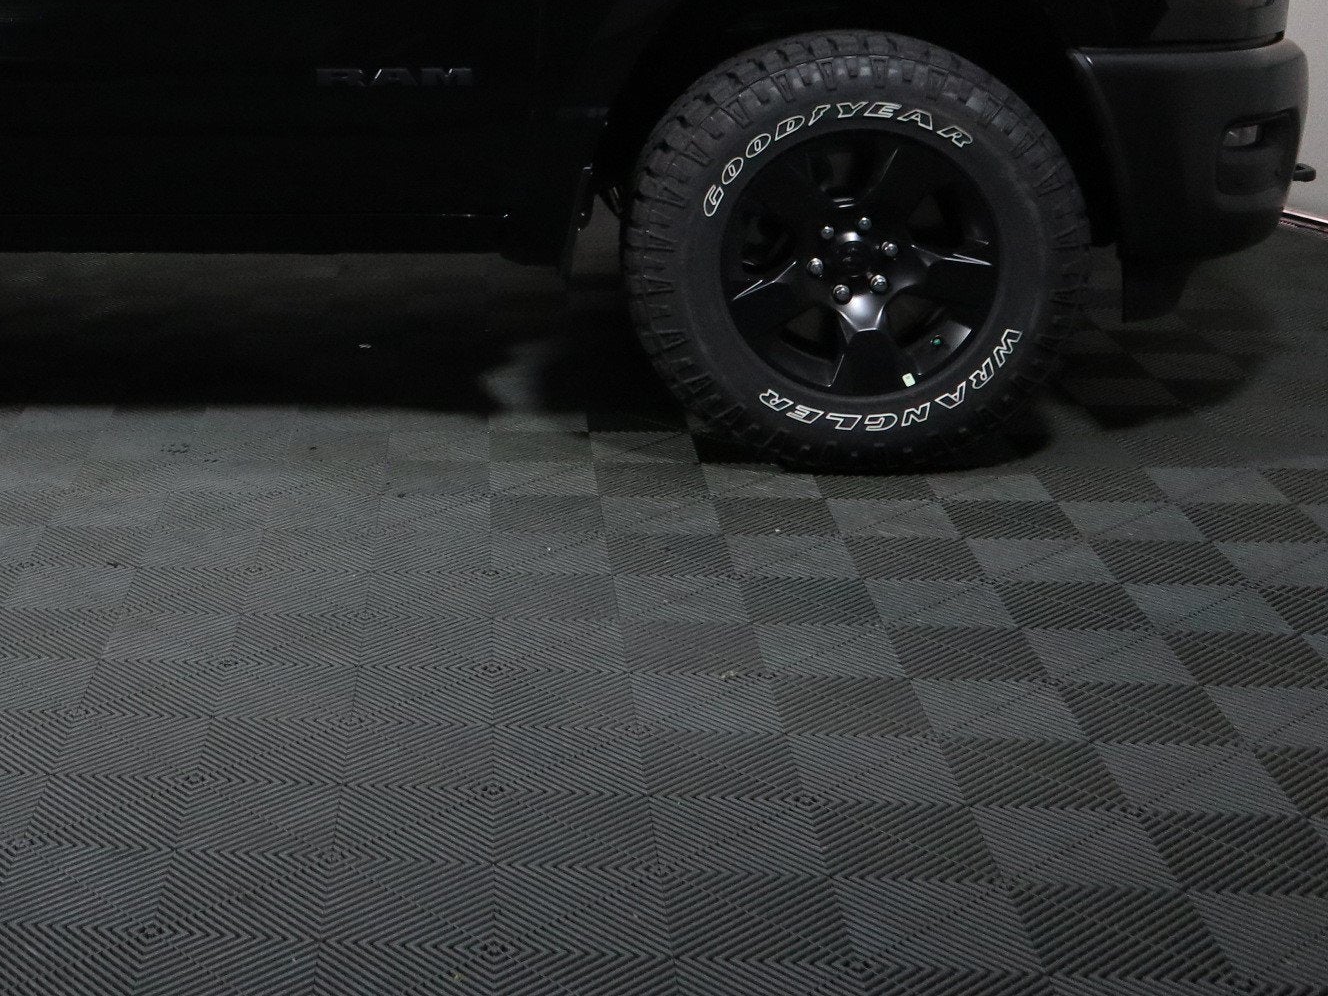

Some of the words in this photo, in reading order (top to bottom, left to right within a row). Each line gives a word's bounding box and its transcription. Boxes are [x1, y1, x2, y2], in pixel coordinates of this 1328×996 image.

[316, 68, 472, 86] RAM
[703, 102, 972, 216] GOODYEAR
[759, 329, 1022, 432] WRANGLER
